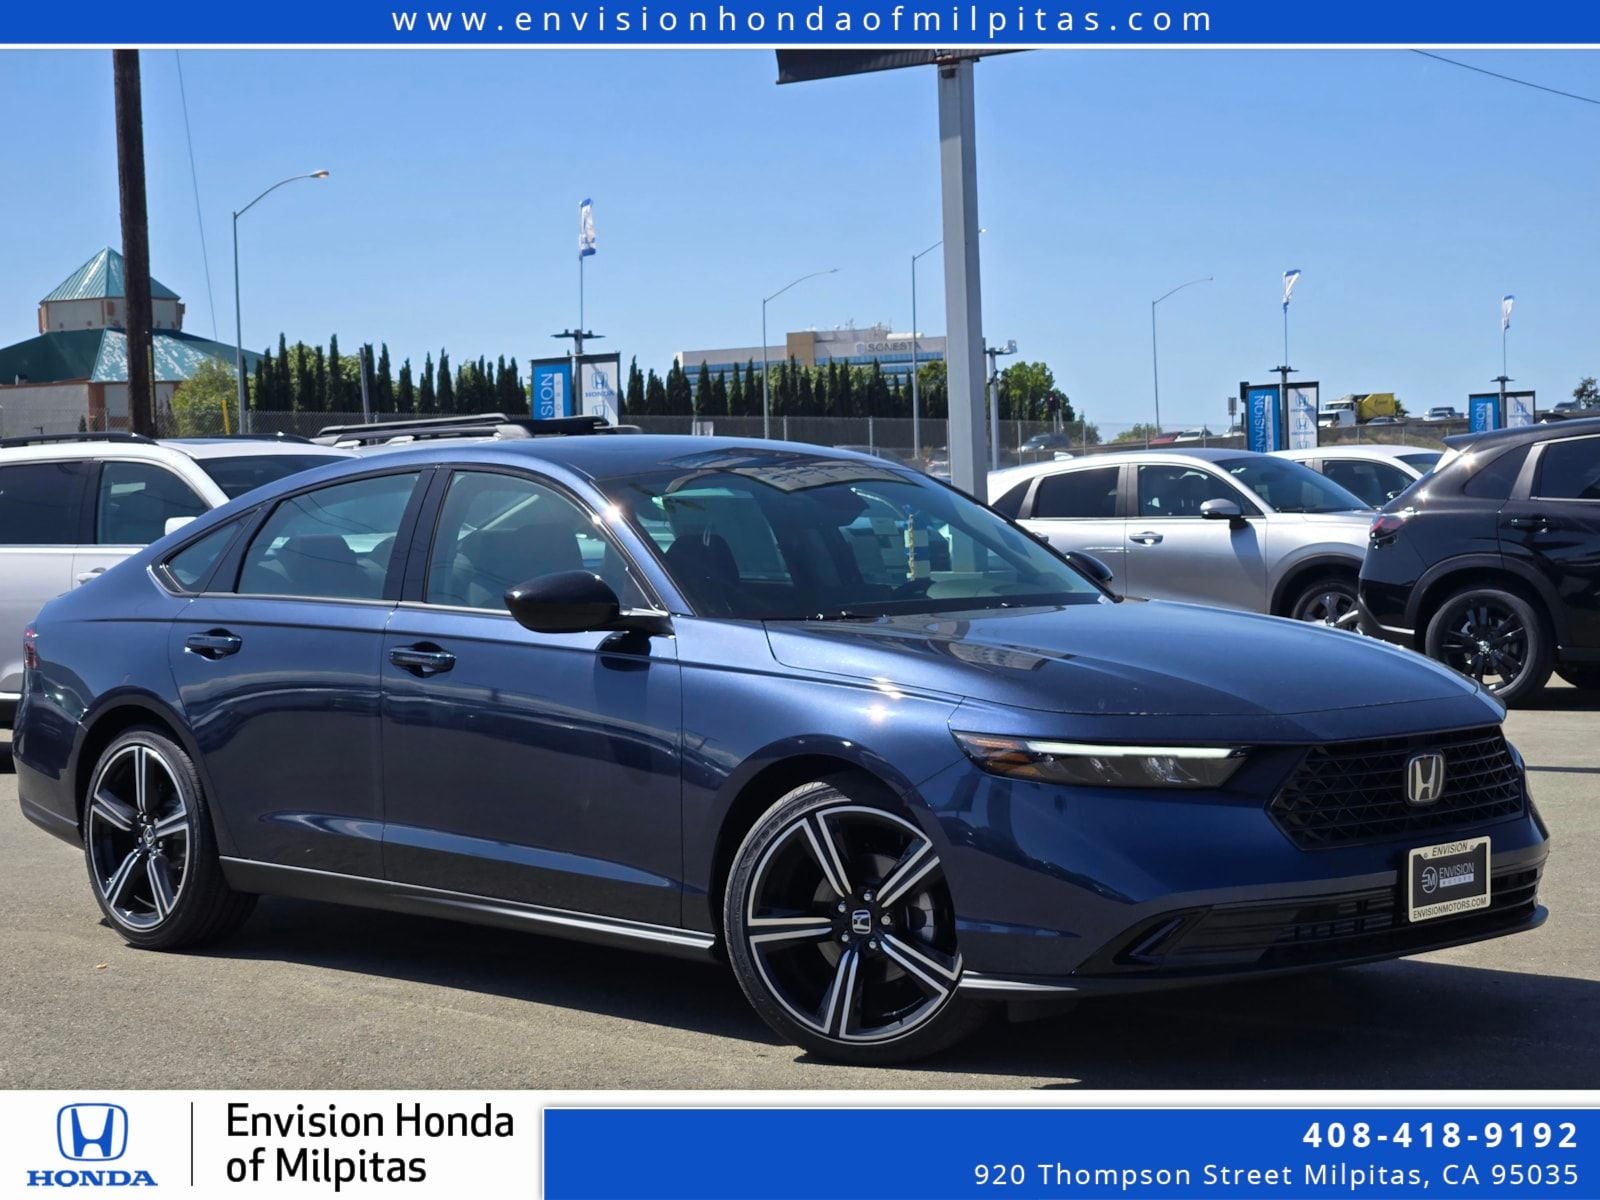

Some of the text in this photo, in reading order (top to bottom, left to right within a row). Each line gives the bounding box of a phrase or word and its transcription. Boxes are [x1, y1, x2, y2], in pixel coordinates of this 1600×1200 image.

[1475, 401, 1487, 433] SION
[1432, 842, 1468, 857] ENVISION
[1439, 862, 1475, 879] ENVISION
[1413, 896, 1487, 919] ENVISIONMOTORS.COM
